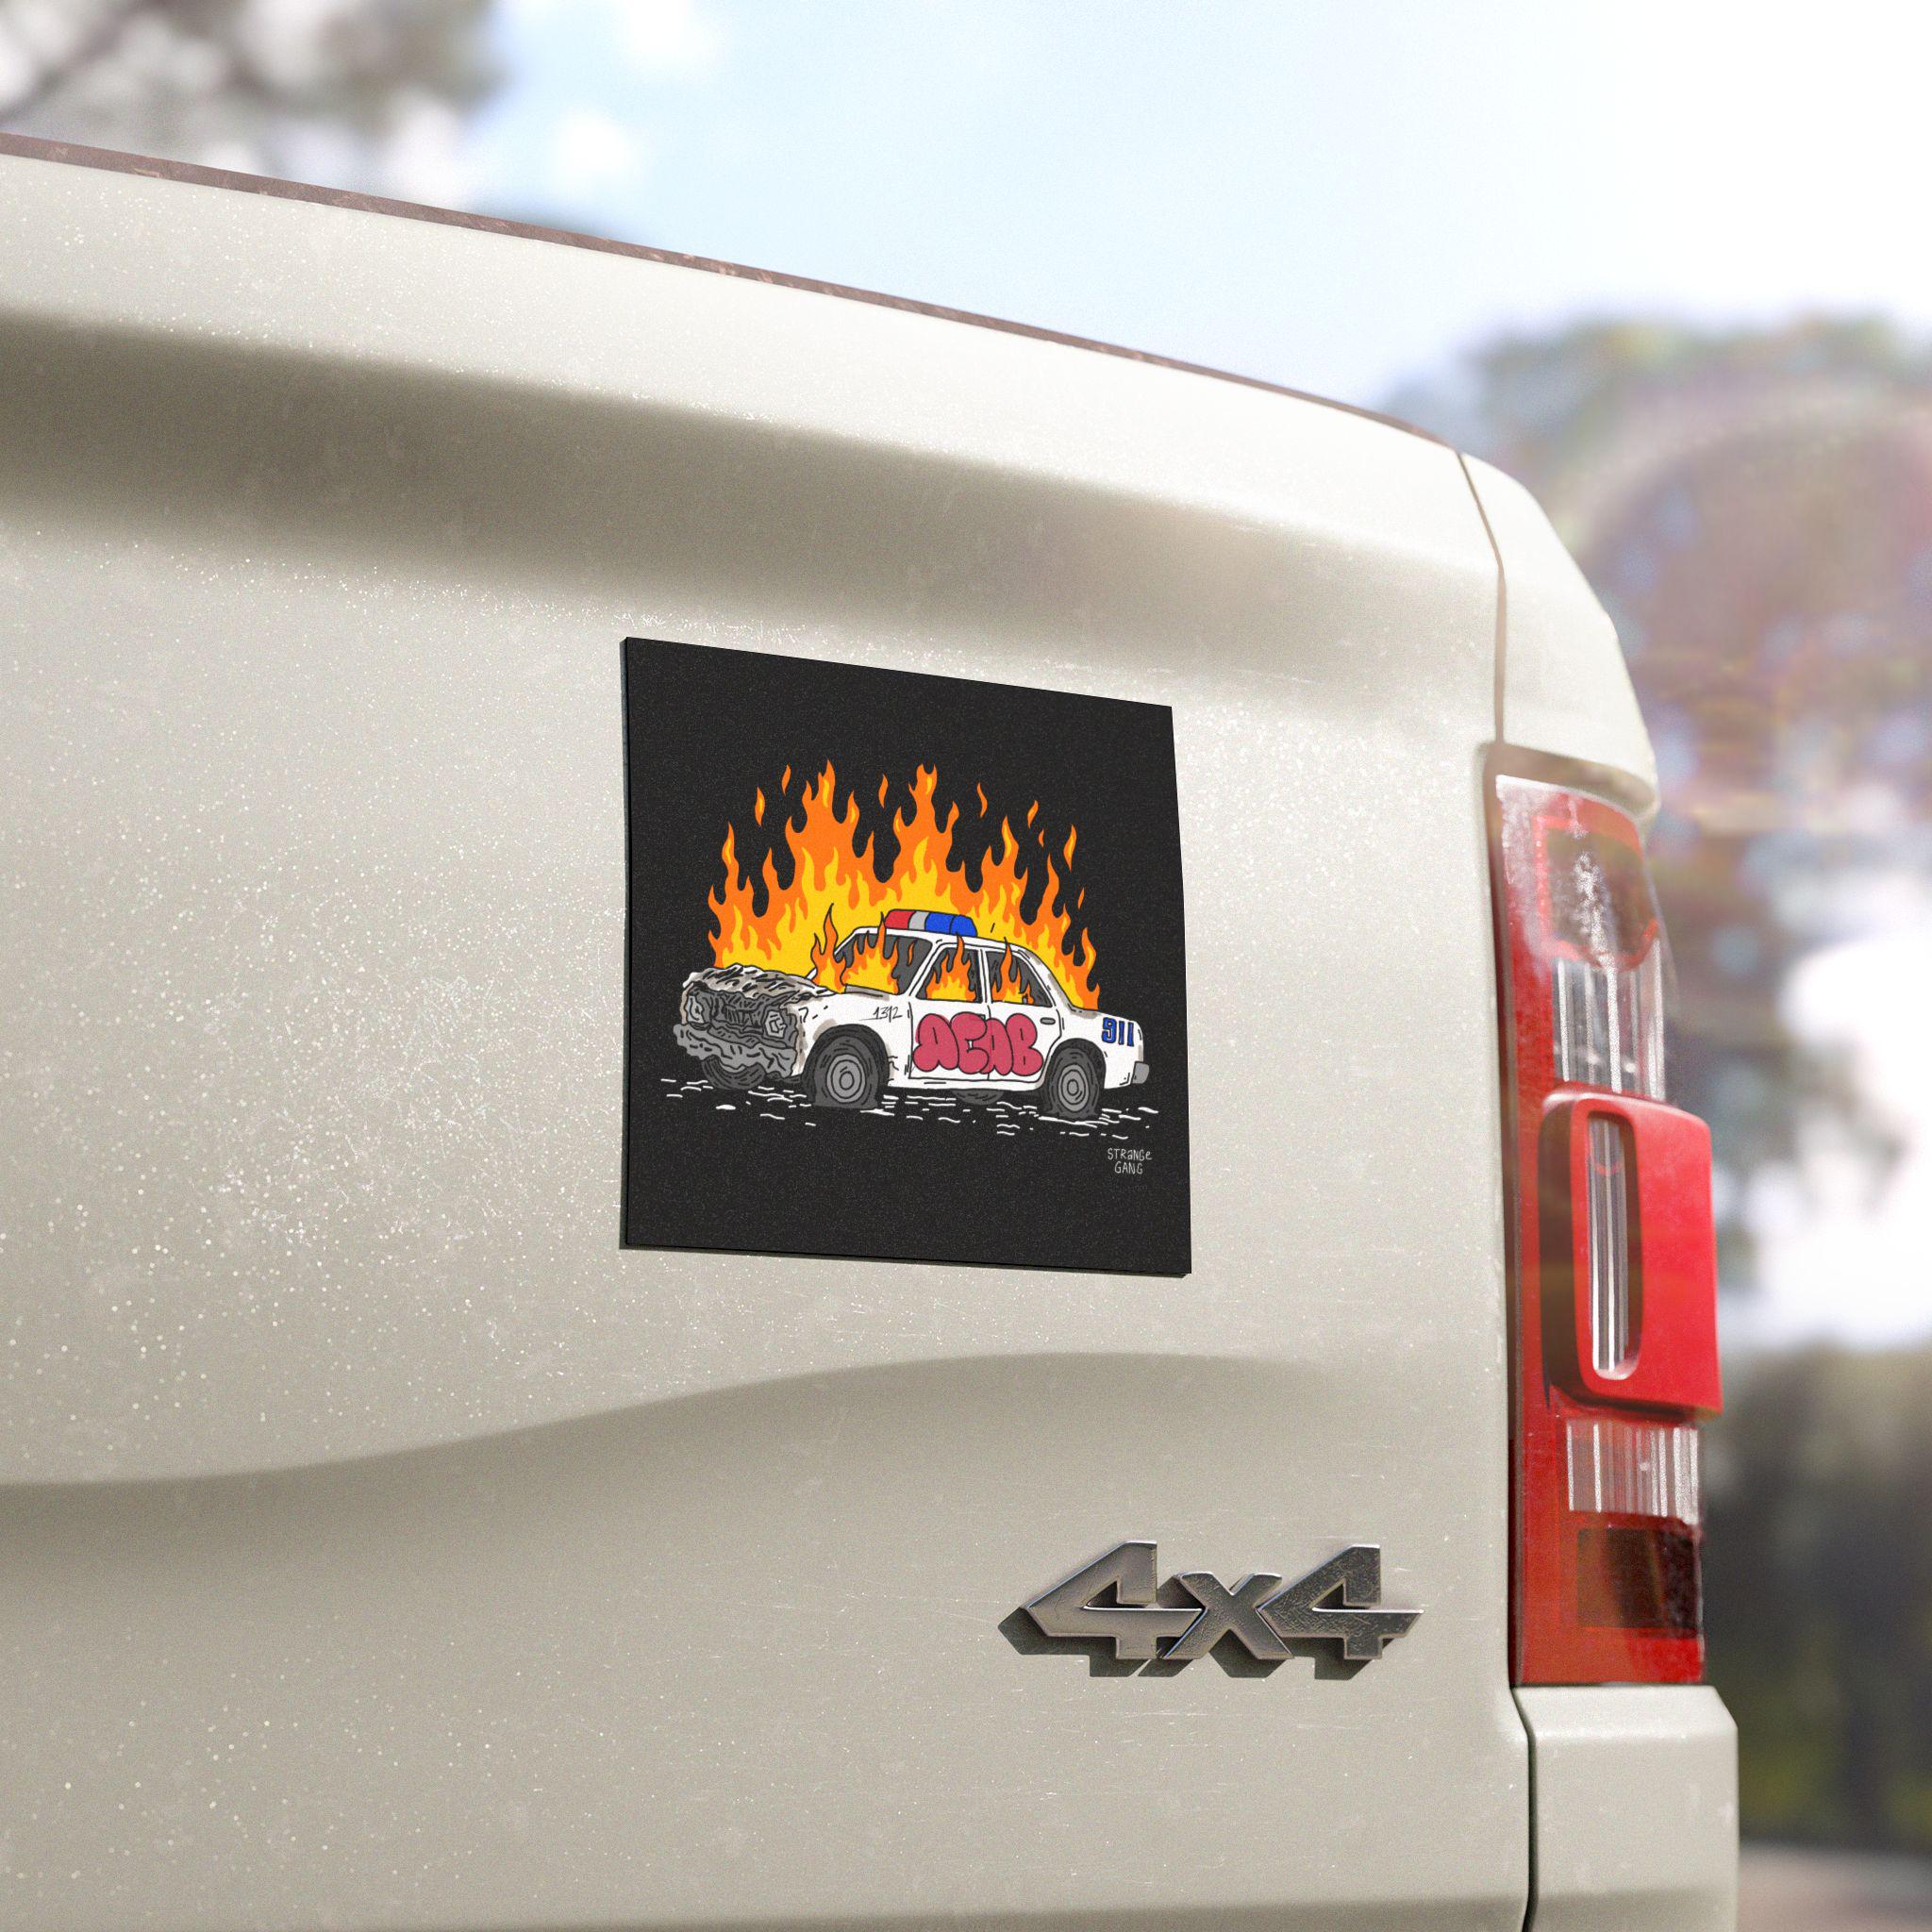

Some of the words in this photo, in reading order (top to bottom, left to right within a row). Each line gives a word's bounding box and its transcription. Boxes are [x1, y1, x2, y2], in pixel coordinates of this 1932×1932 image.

[868, 1006, 903, 1024] 1312
[913, 1011, 1043, 1076] ACAB
[1101, 1017, 1135, 1047] 911
[1114, 1160, 1143, 1174] GANG
[1024, 1540, 1424, 1659] 4x4
